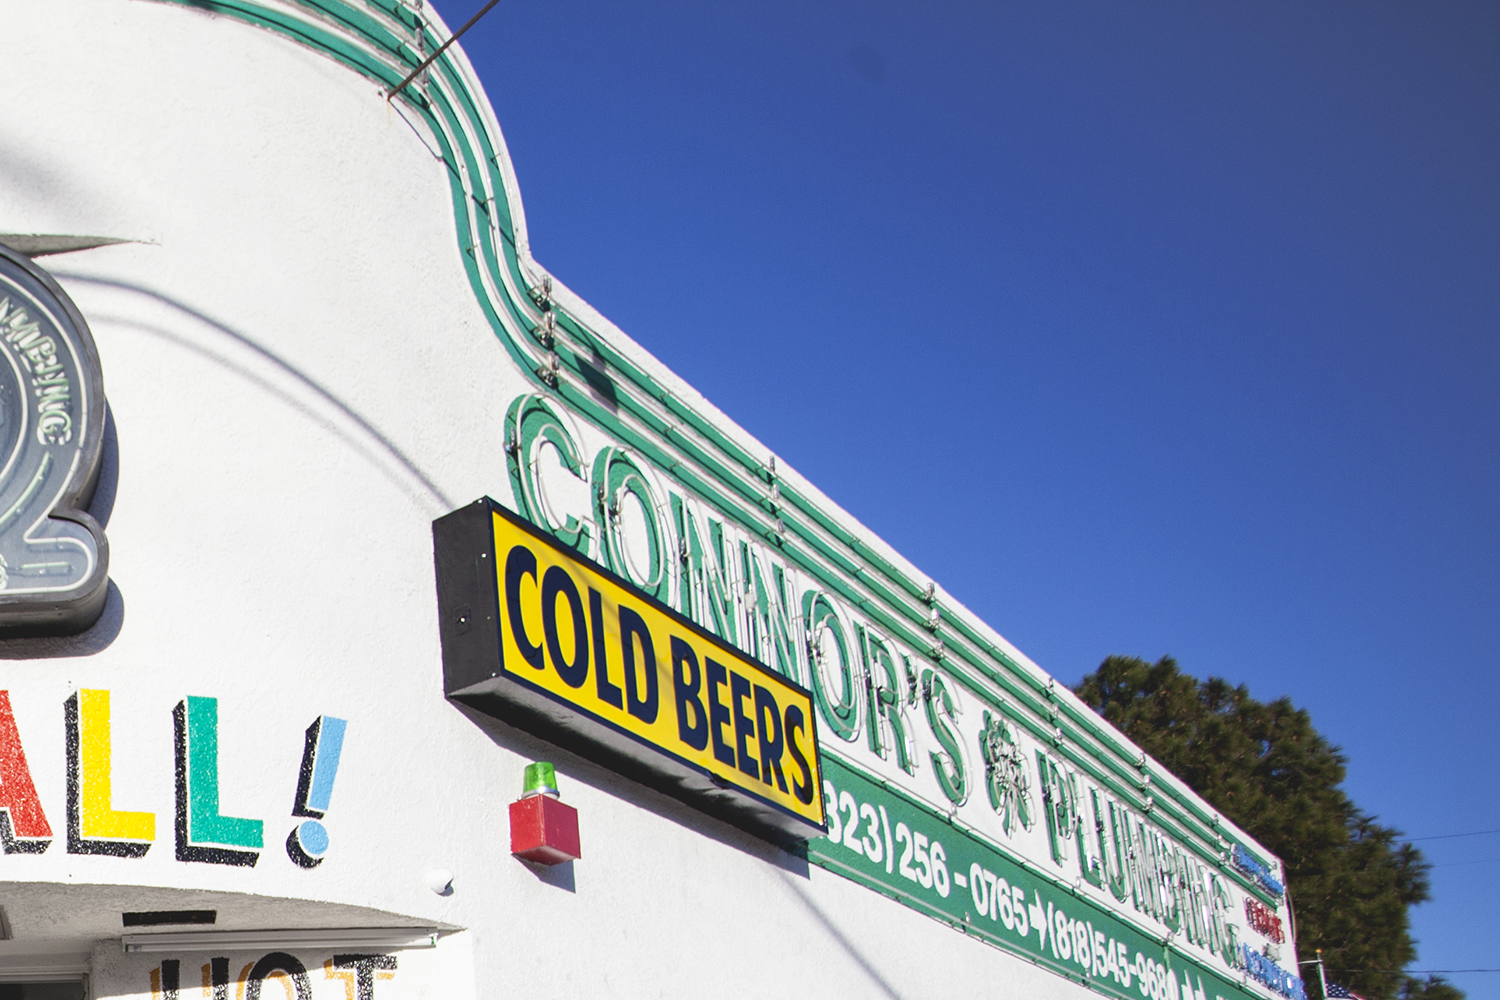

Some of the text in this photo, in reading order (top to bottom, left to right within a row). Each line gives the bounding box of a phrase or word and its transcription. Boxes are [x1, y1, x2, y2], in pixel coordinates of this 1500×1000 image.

[503, 389, 973, 808] CONNOR'S
[504, 544, 816, 806] COLD BEERS
